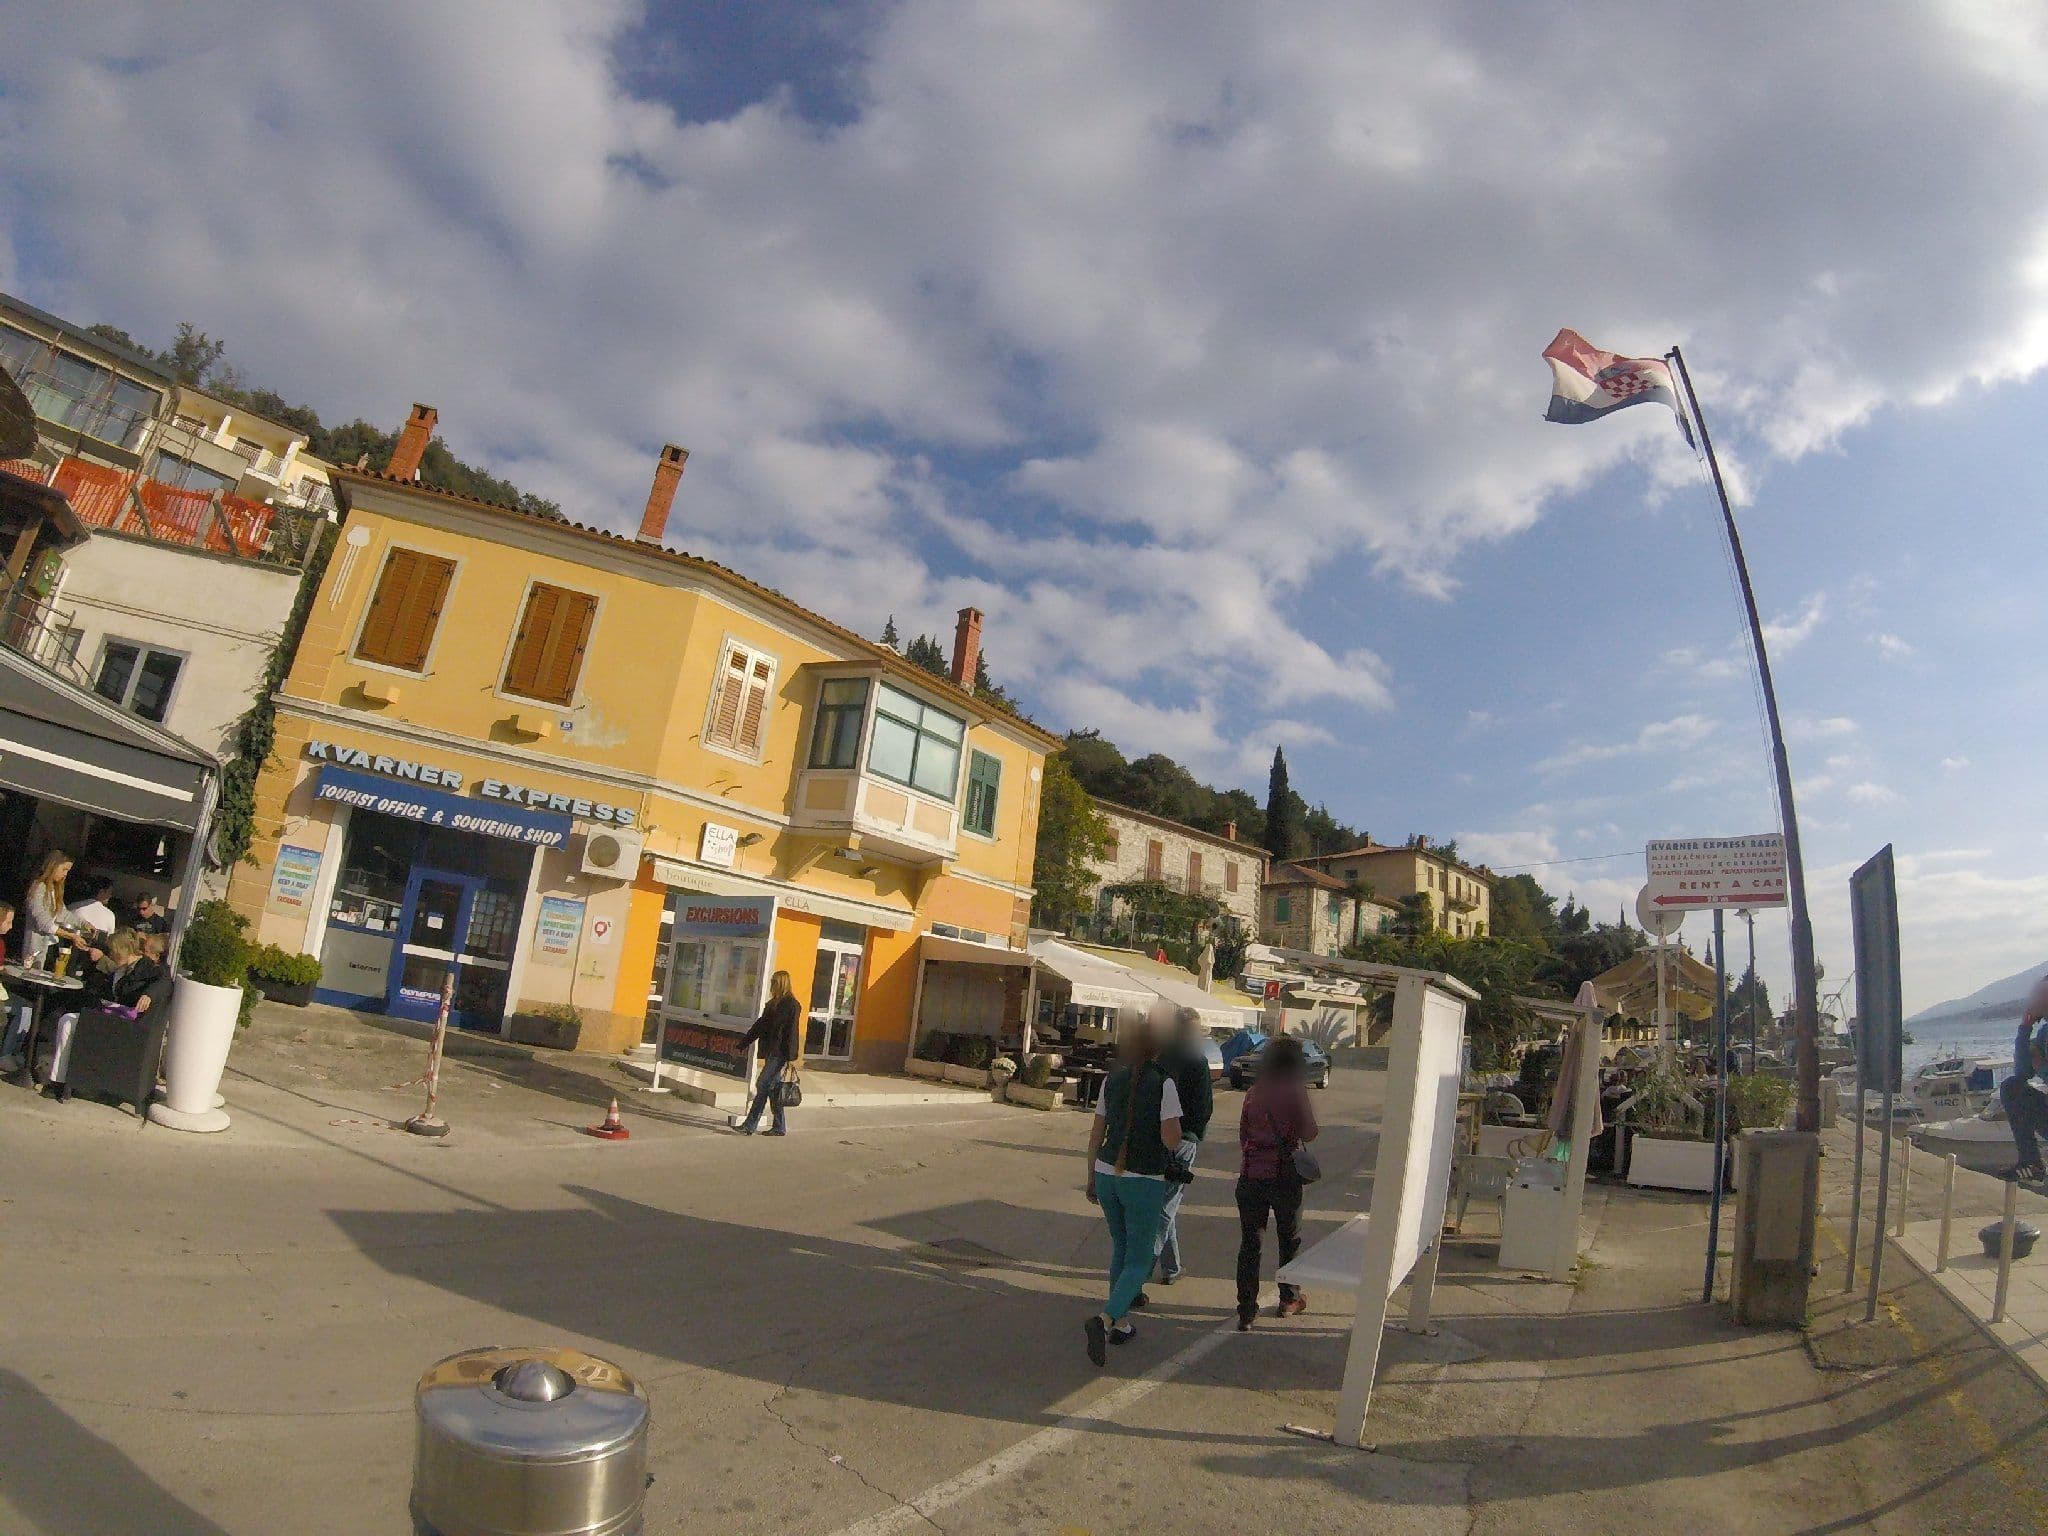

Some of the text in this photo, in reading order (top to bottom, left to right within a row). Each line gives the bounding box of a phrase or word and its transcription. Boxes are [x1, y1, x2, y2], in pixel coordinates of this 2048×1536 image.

[308, 740, 636, 824] KVARNER EXPRESS
[319, 784, 563, 845] TOURIST OFFICE & SOUVENIR SHOP
[709, 827, 735, 843] ELLA
[1651, 842, 1698, 851] KVARNER
[1703, 840, 1746, 849] EXPRESS
[1679, 878, 1784, 890] RENT A CAR
[785, 896, 810, 911] ELLA
[685, 906, 760, 925] EXCURSIONS
[400, 987, 441, 1000] OLYMPUS
